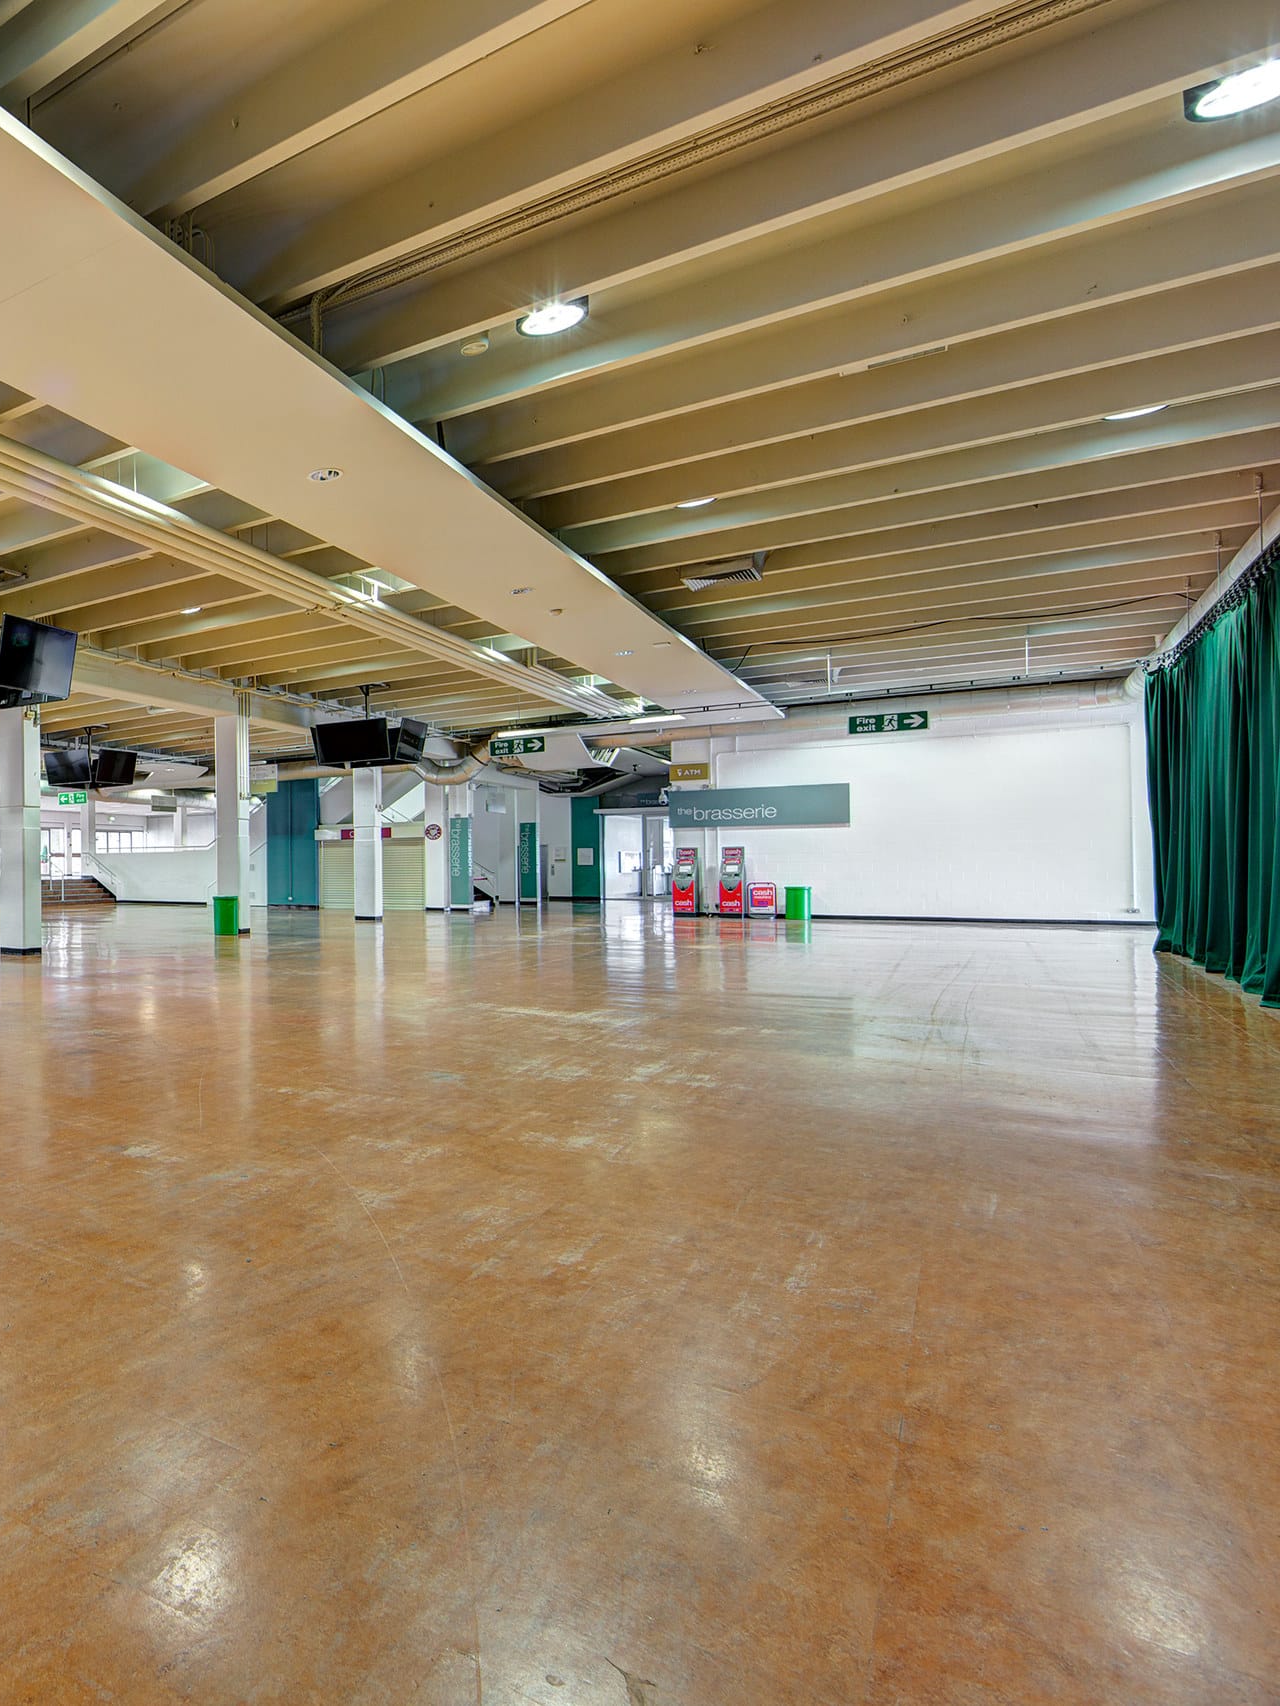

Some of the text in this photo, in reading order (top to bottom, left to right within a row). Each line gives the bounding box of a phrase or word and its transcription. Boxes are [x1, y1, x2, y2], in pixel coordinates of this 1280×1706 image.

[856, 717, 876, 725] Fire
[856, 724, 876, 732] exit
[677, 804, 776, 821] the brasserie
[451, 828, 462, 877] brasserie
[521, 832, 532, 874] brasserie
[753, 888, 773, 896] cash
